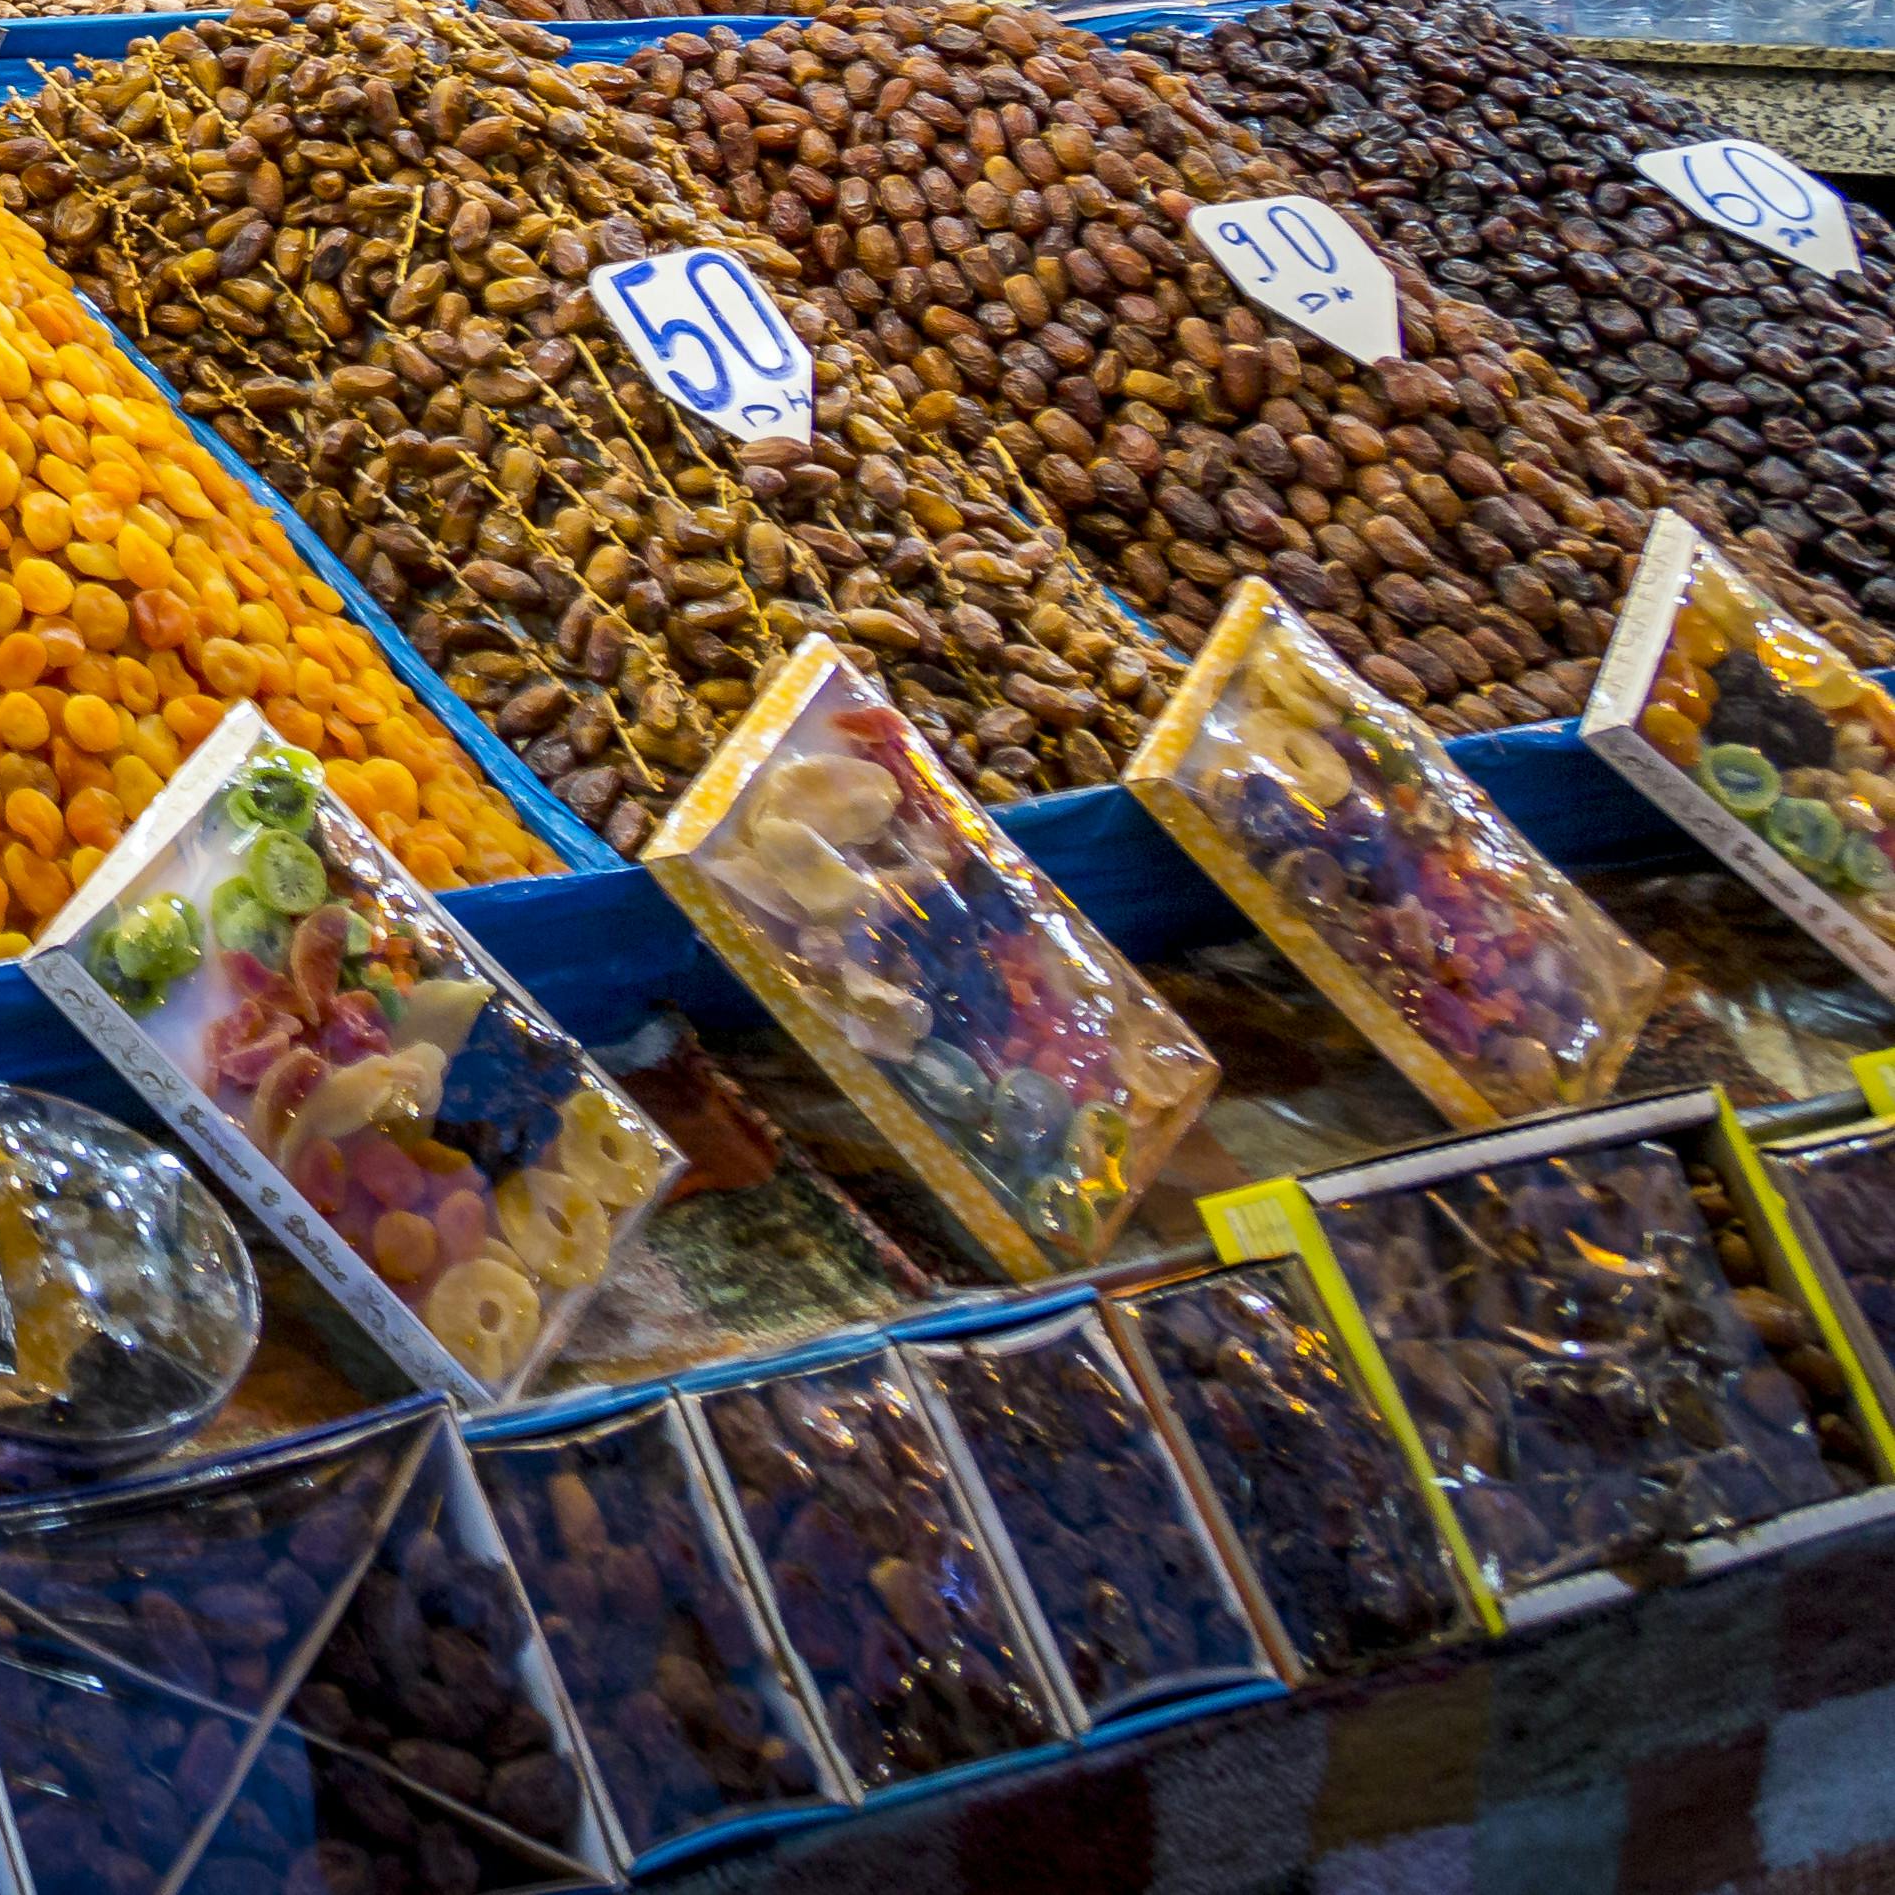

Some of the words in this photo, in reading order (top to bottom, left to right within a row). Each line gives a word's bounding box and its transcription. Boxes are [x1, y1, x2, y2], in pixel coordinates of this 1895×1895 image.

[1682, 147, 1815, 227] 60
[1217, 205, 1339, 284] 90
[610, 251, 799, 412] 50
[1296, 287, 1354, 315] DH
[741, 389, 811, 428] DH
